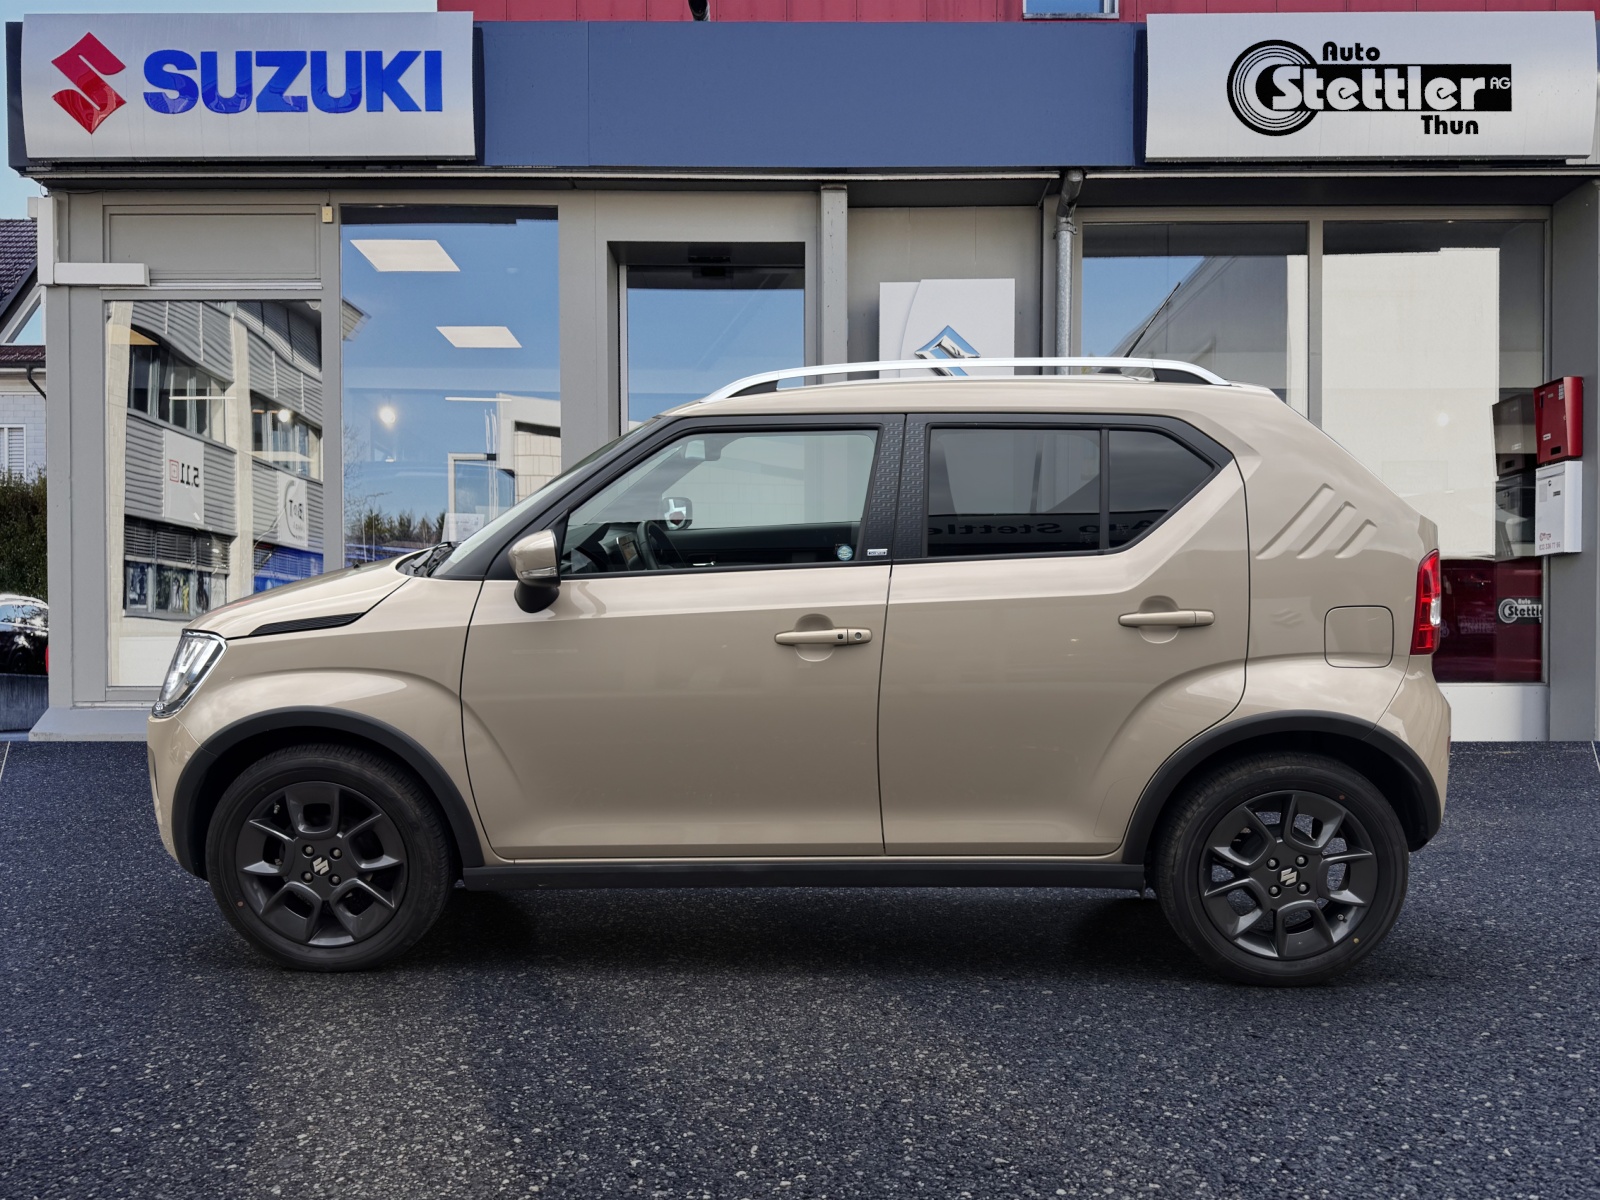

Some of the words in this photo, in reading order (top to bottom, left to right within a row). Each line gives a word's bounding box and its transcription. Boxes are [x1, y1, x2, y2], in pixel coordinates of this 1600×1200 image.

[1322, 41, 1381, 61] Auto
[143, 49, 443, 115] SUZUKI
[1271, 65, 1486, 111] Stettler
[1489, 77, 1511, 90] AG
[1420, 114, 1479, 135] Thun
[1508, 605, 1543, 617] Stettl
